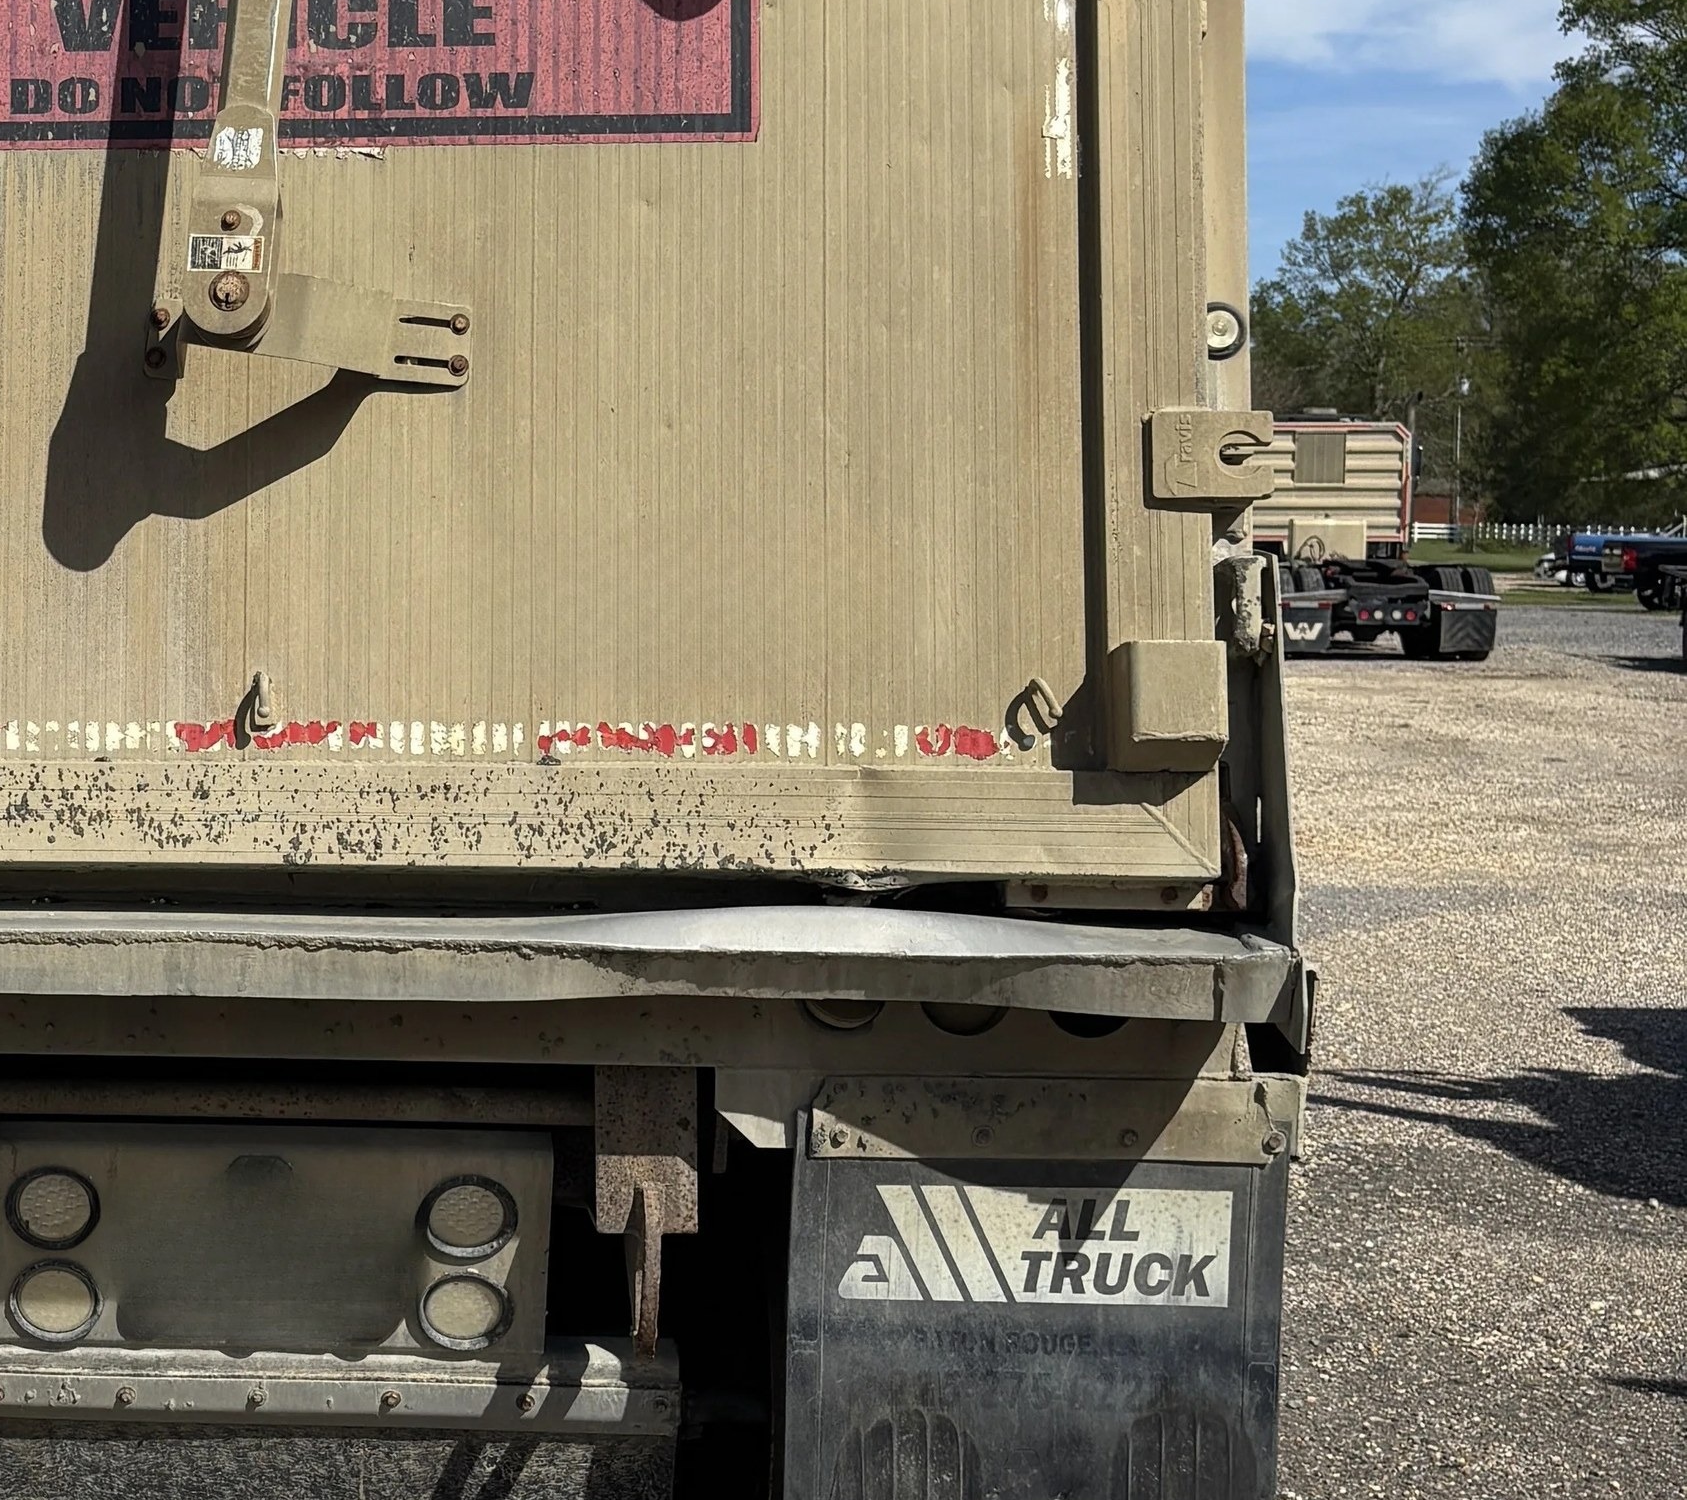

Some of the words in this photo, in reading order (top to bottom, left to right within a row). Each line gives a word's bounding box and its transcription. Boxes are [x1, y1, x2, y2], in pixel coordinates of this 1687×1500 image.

[11, 77, 101, 115] DO
[120, 76, 222, 114] NO
[1164, 412, 1200, 496] Travis
[1031, 1198, 1142, 1242] ALL
[1019, 1250, 1219, 1298] TRUCK
